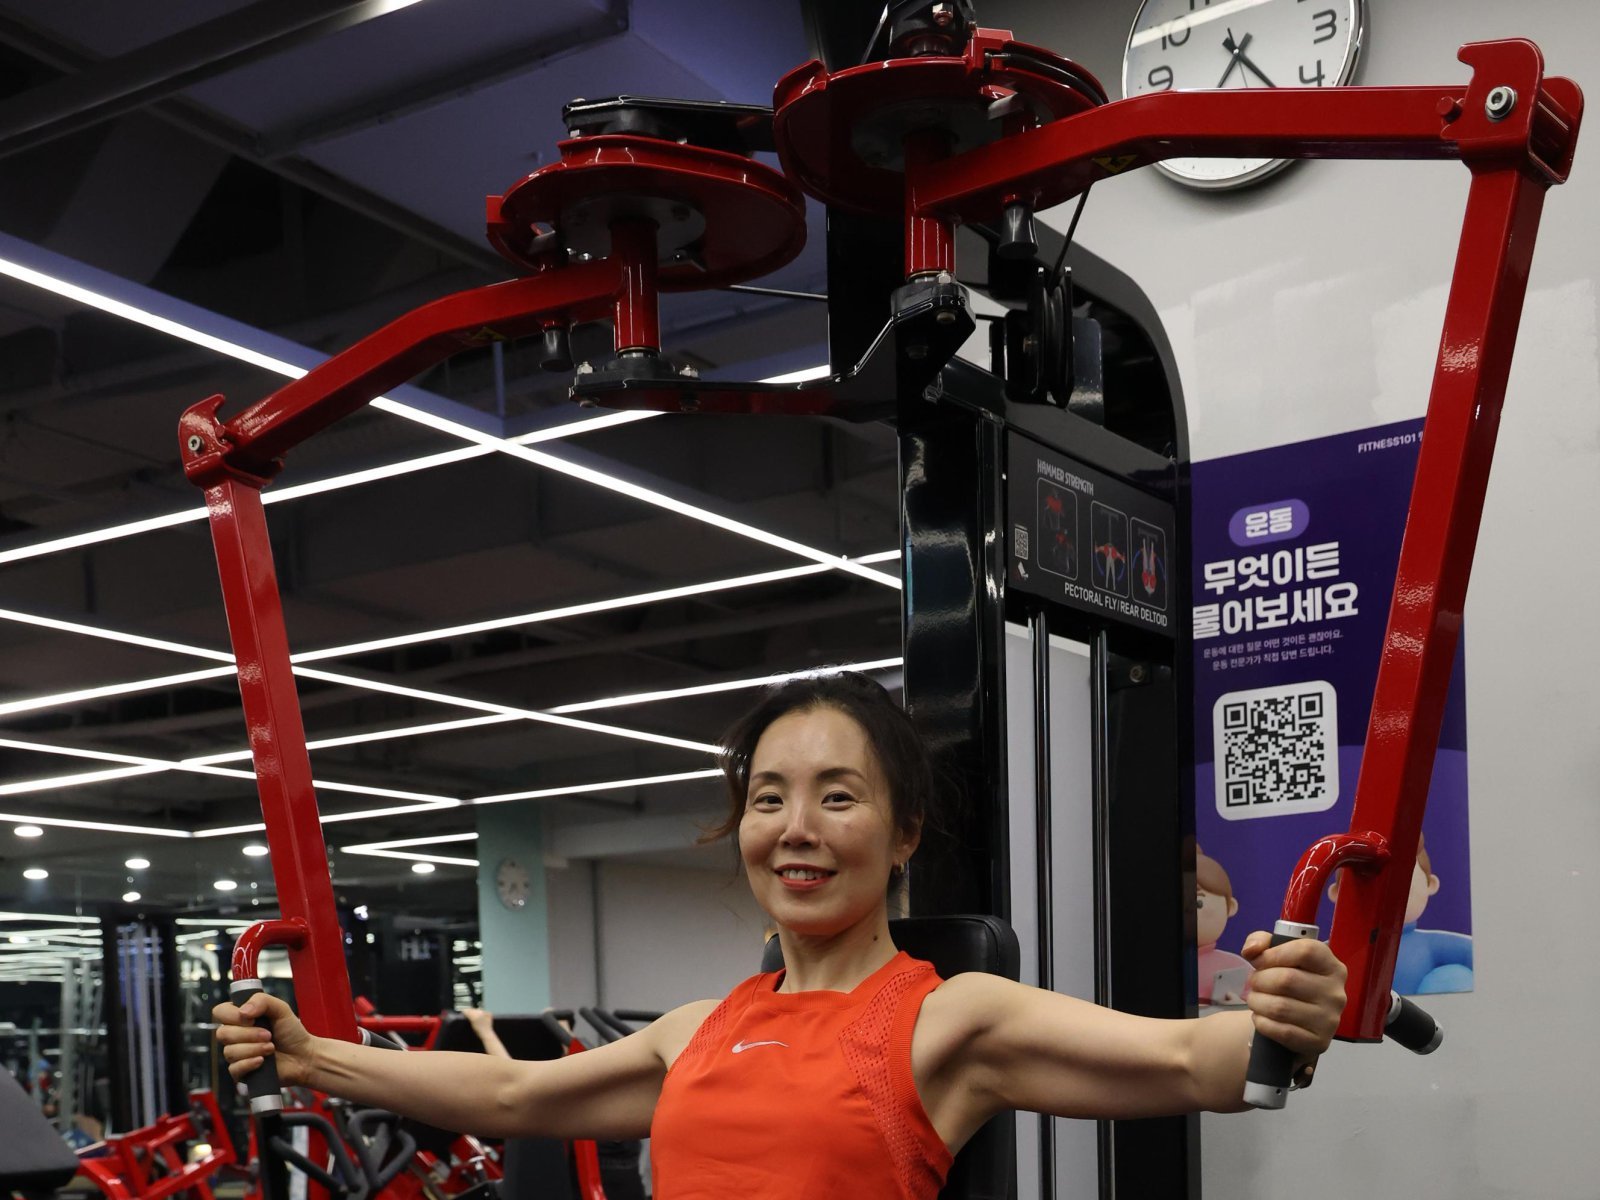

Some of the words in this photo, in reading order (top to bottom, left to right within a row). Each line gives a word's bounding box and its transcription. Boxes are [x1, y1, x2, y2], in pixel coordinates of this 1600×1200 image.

[1312, 9, 1337, 45] 3
[1298, 59, 1326, 87] 4
[1358, 433, 1416, 453] FITNESS101
[1037, 458, 1065, 484] HAMMER
[1065, 470, 1094, 496] STRENGTH
[1245, 506, 1293, 538] 운동
[1204, 541, 1340, 596] 무엇이든
[1064, 582, 1104, 607] PECTORAL
[1140, 609, 1168, 627] DELTOID
[1193, 582, 1359, 640] 물어보세요
